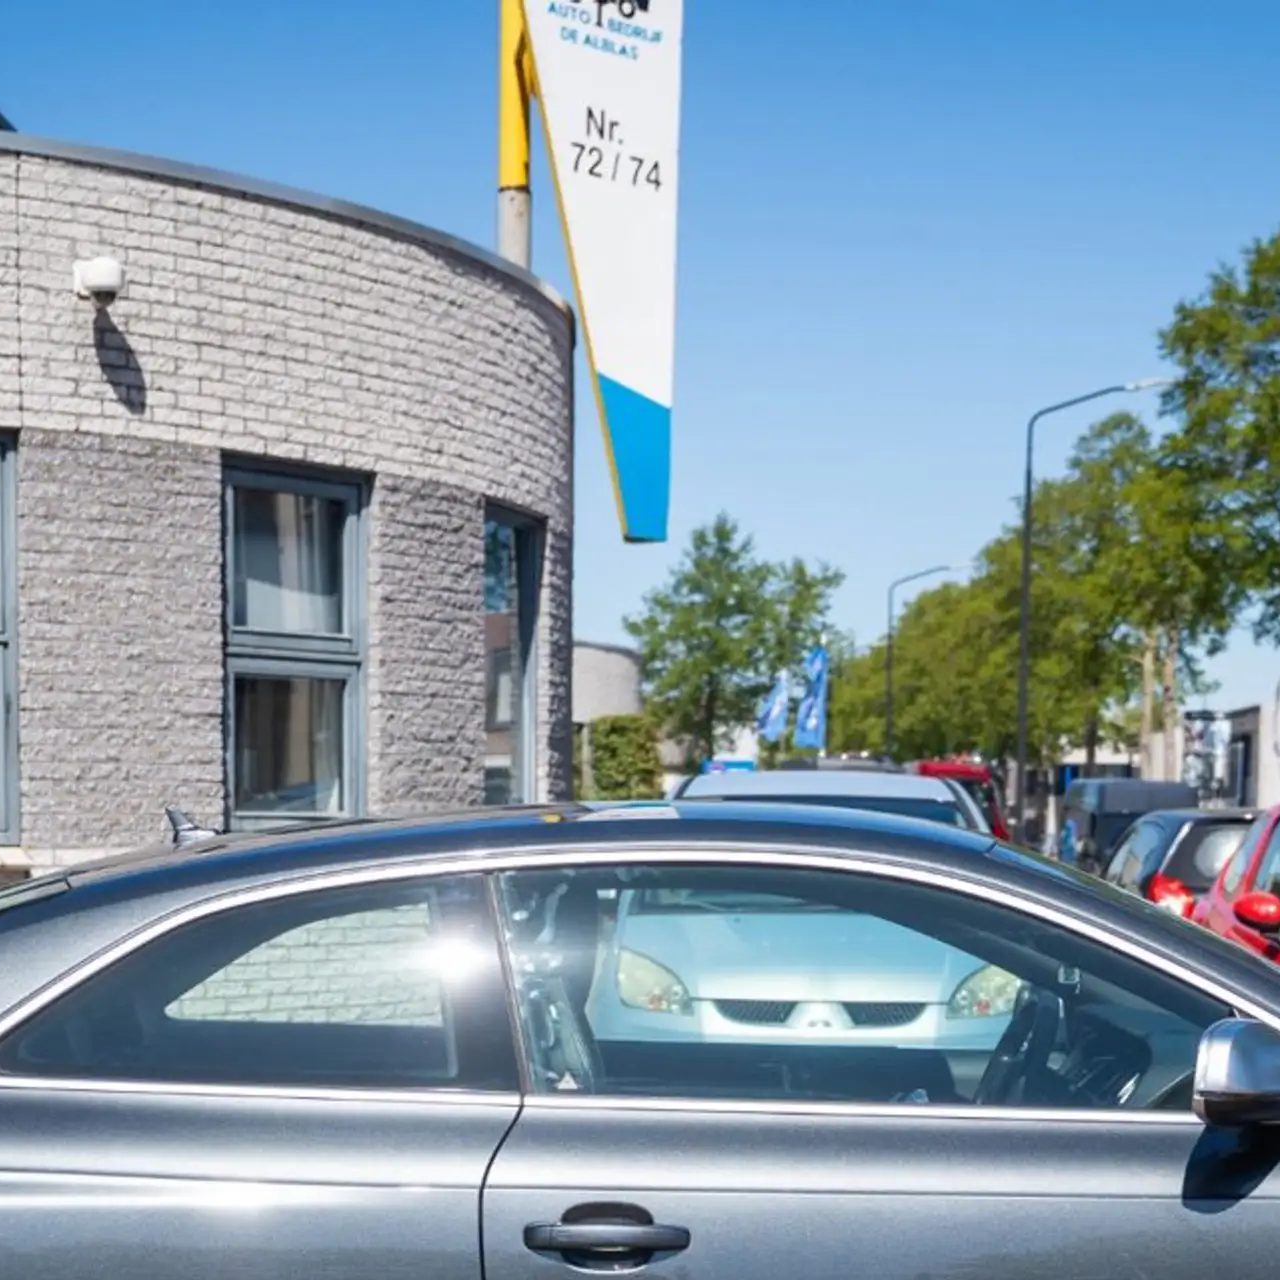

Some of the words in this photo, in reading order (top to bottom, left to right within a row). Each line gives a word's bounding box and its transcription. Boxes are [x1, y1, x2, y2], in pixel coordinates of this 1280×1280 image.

[547, 1, 591, 24] AUTO
[560, 26, 578, 44] DE
[583, 34, 638, 60] ALBLAS
[586, 105, 624, 145] Nr.
